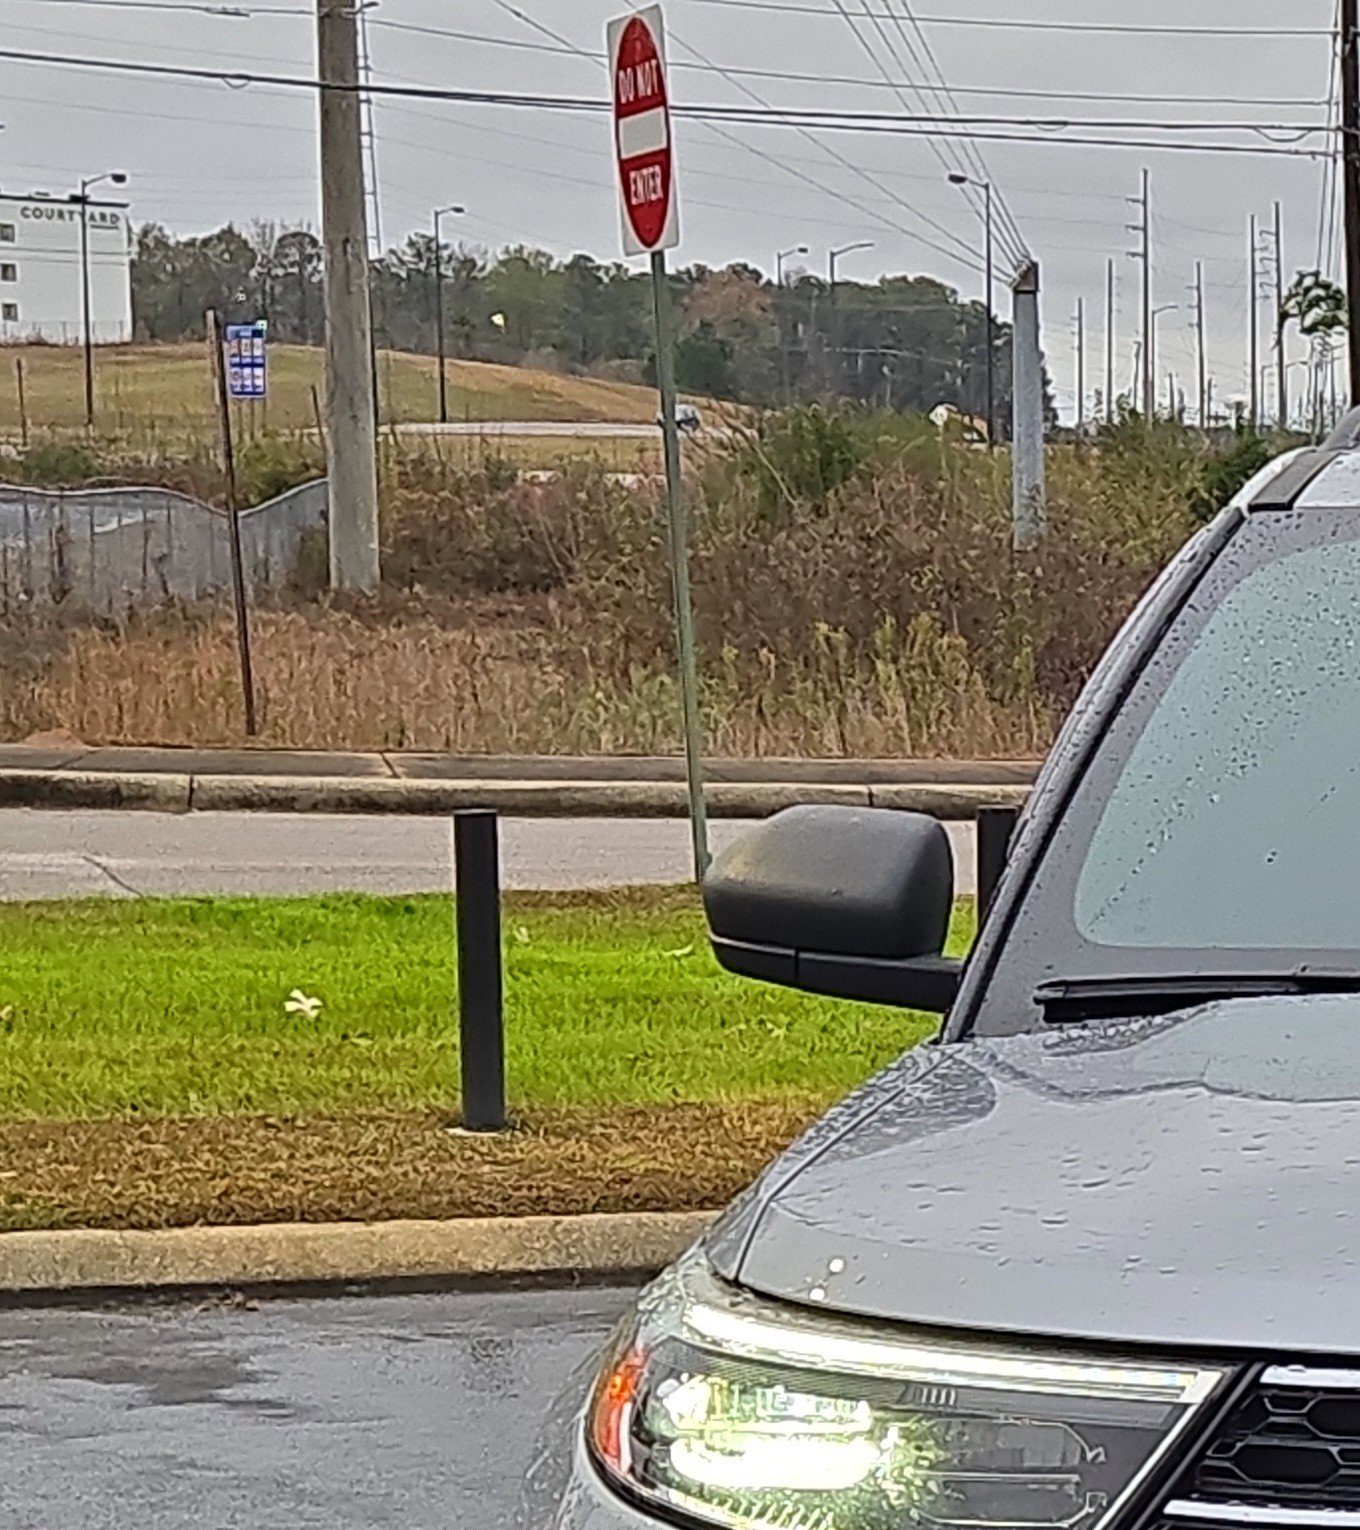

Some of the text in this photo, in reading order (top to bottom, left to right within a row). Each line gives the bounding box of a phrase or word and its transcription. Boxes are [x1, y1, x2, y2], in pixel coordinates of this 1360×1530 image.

[618, 58, 659, 104] DO NOT
[629, 164, 664, 206] ENTER
